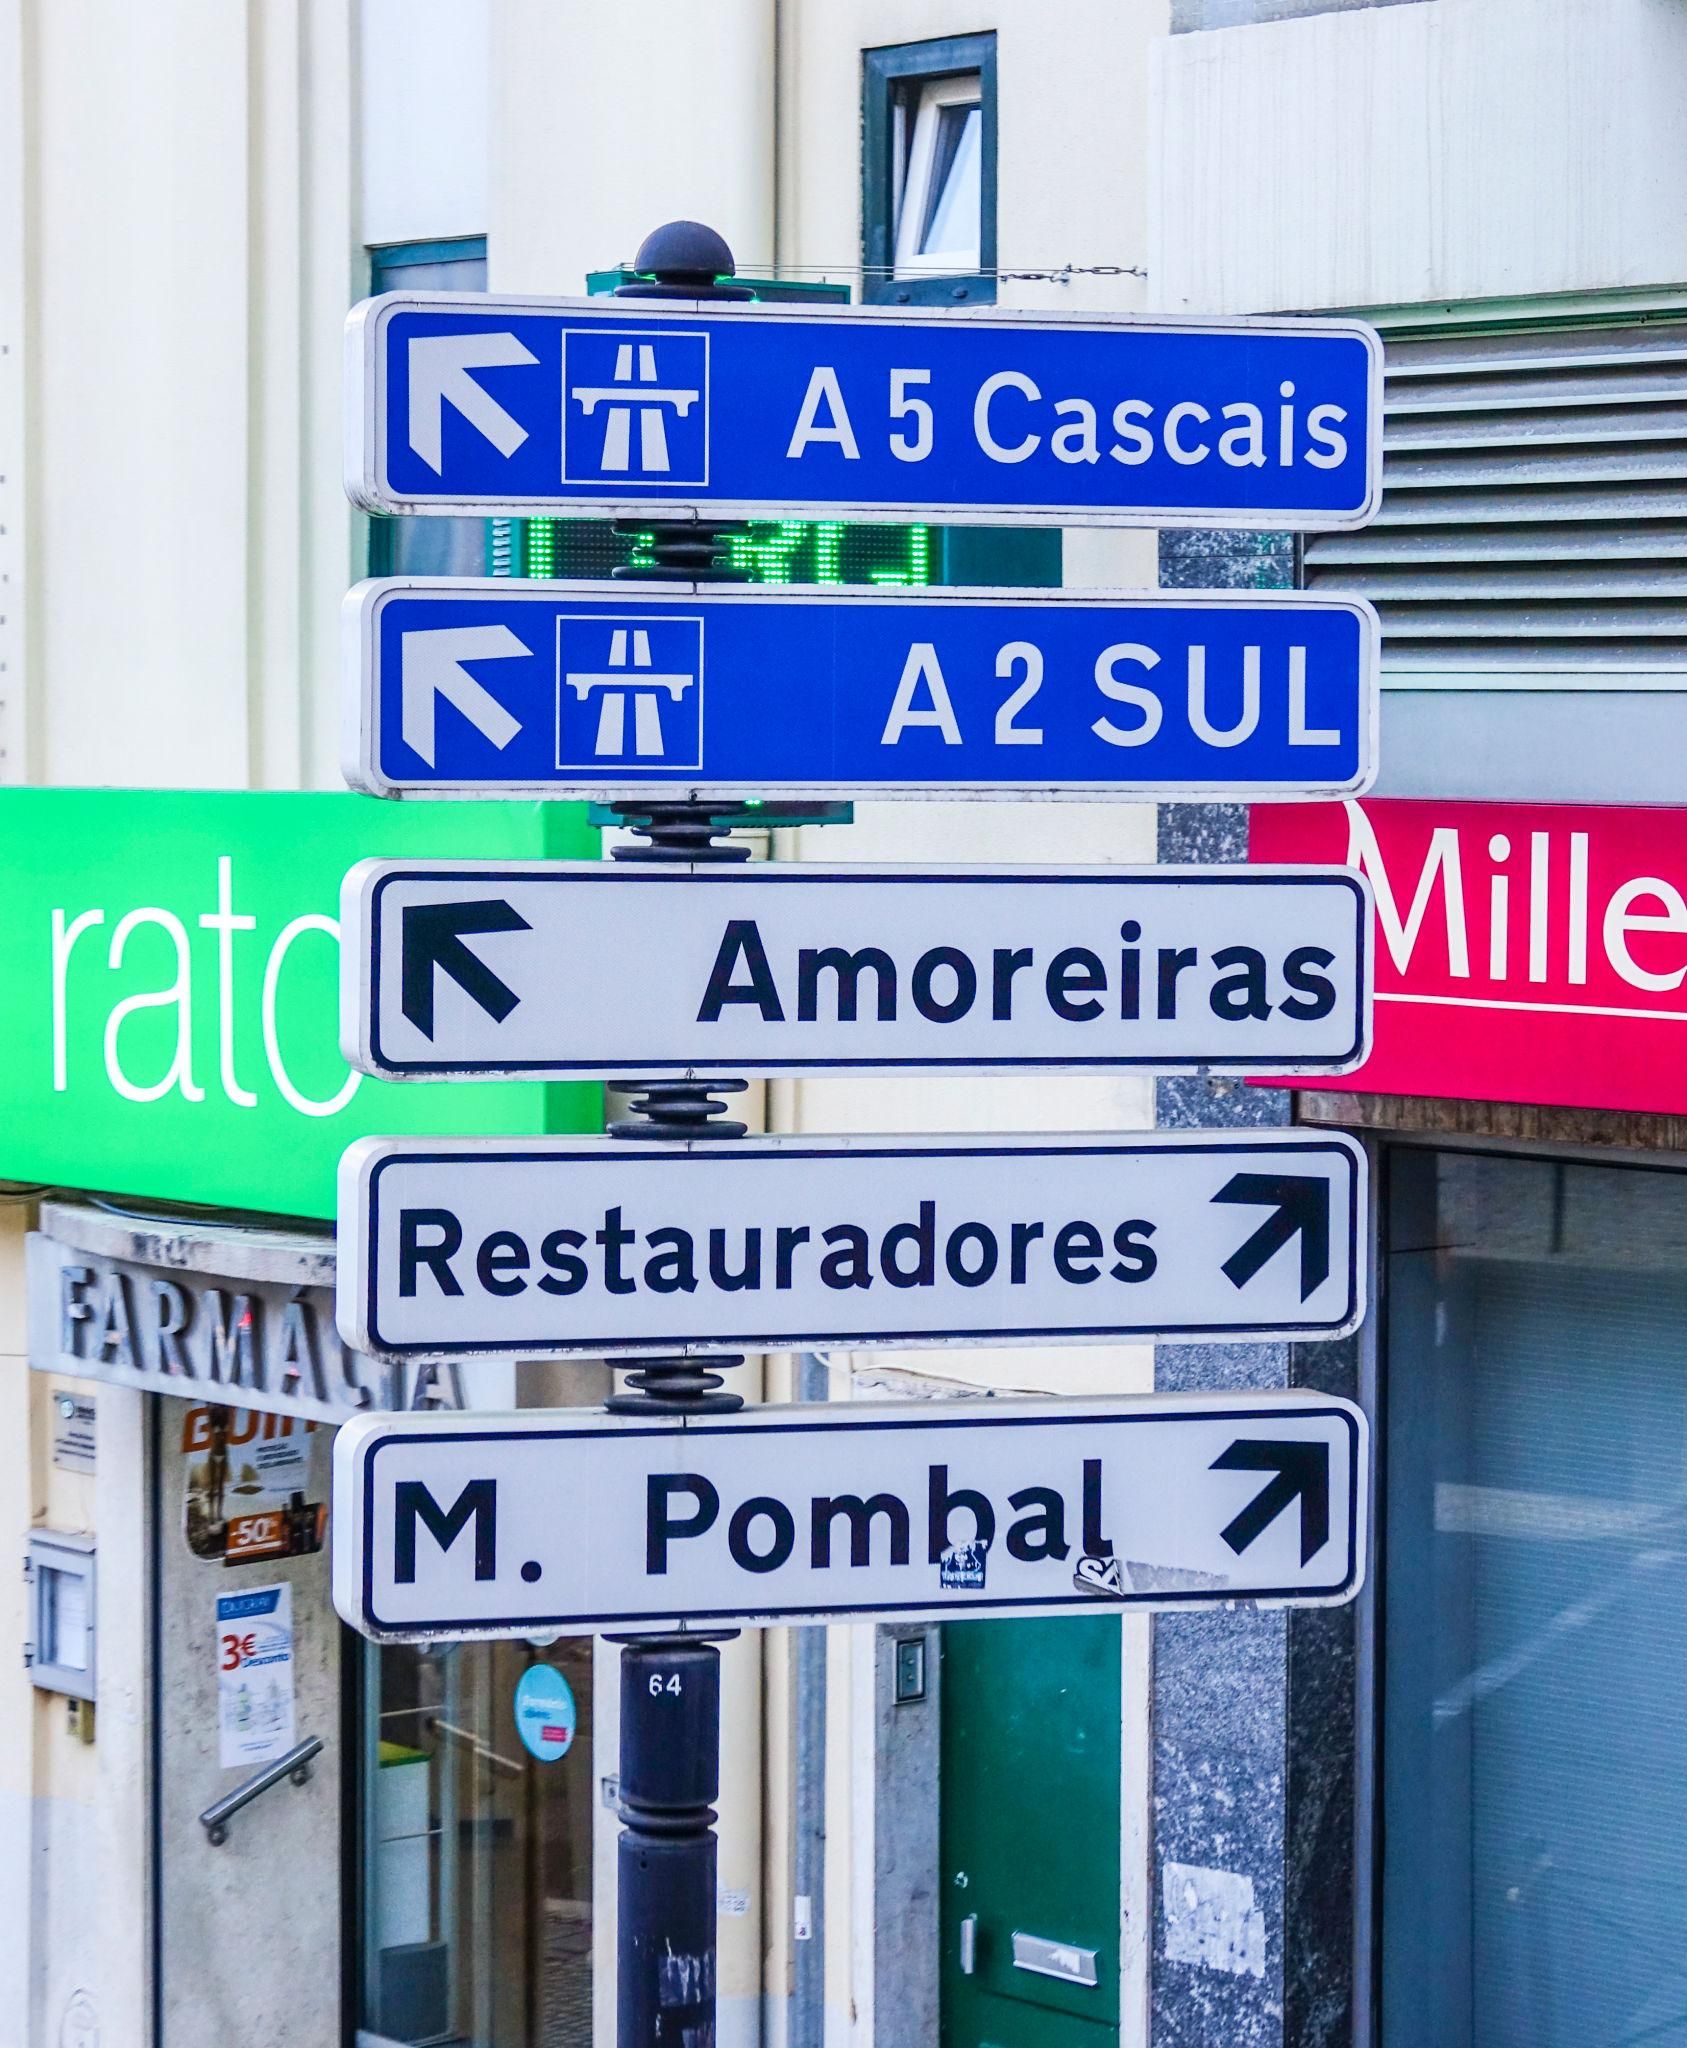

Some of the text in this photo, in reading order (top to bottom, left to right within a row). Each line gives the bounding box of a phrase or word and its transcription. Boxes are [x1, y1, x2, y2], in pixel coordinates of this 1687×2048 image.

[786, 366, 1348, 469] A 5 Cascais
[881, 641, 1342, 748] A 2 SUL
[1343, 800, 1687, 992] Mille
[52, 856, 363, 1117] rato
[696, 919, 1337, 1024] Amoreiras
[399, 1200, 1158, 1298] Restauradores
[394, 1458, 1114, 1585] M. Pombal
[222, 1633, 257, 1671] 3€
[649, 1673, 682, 1697] 64
